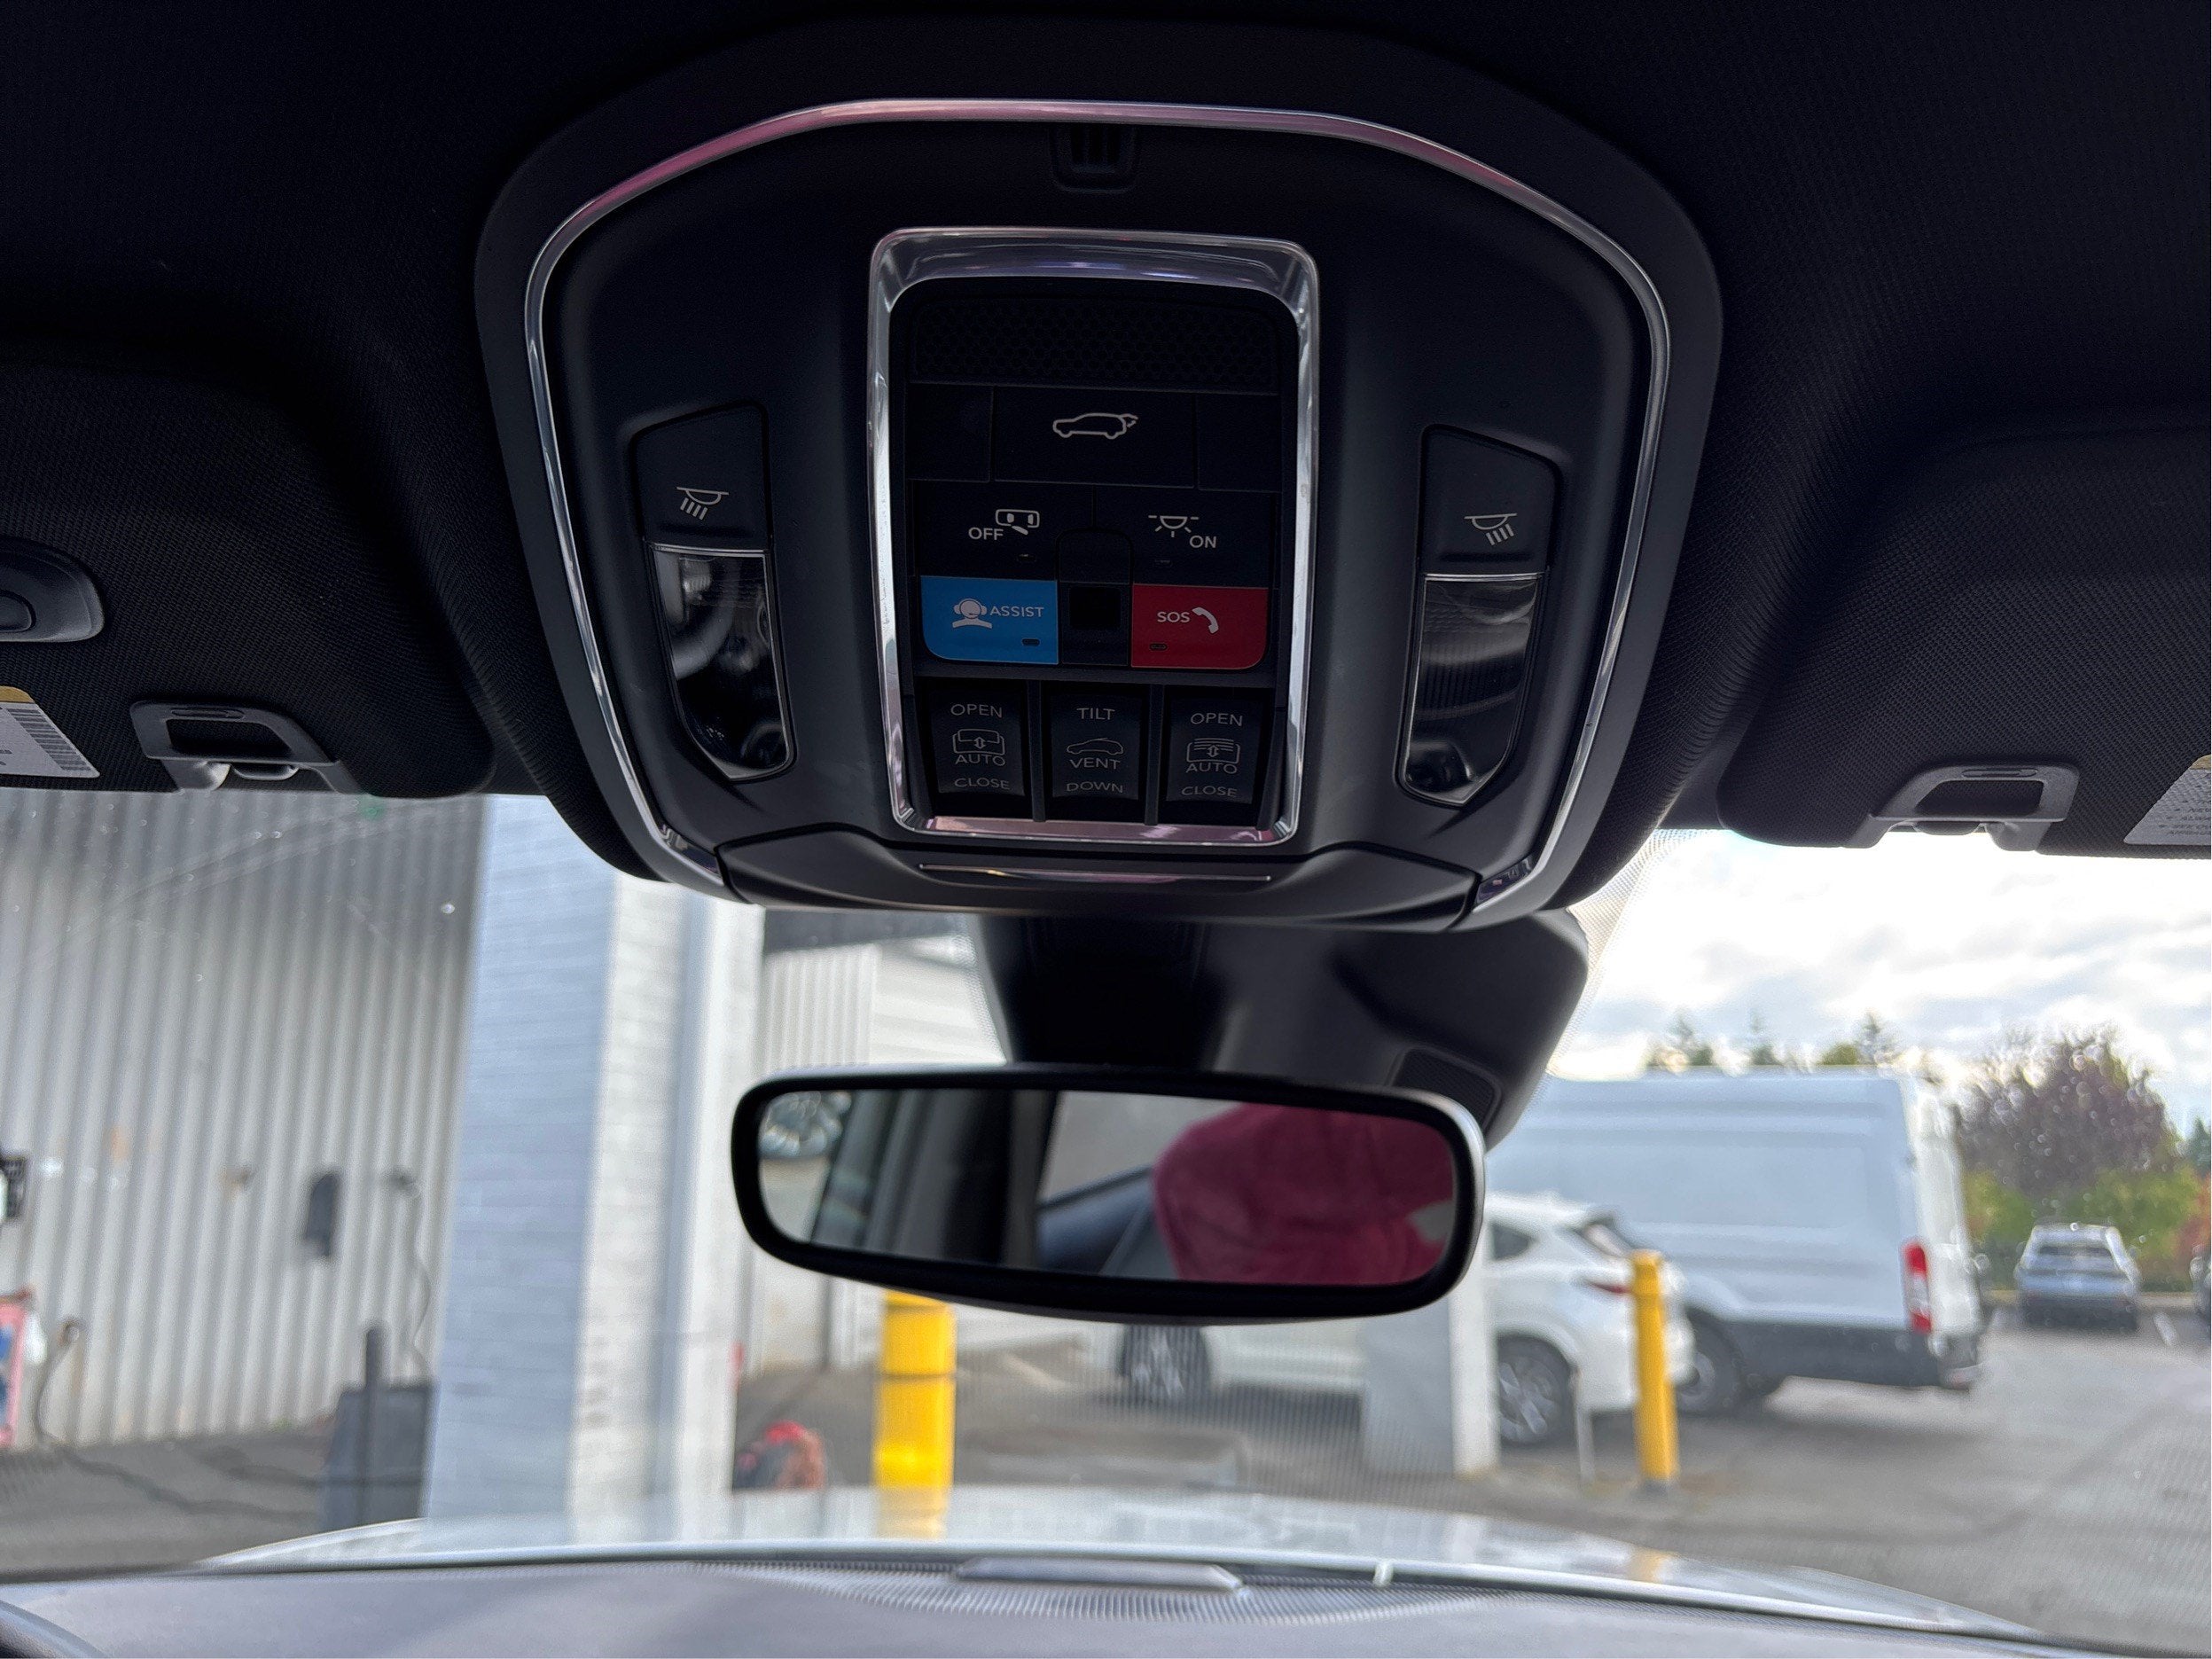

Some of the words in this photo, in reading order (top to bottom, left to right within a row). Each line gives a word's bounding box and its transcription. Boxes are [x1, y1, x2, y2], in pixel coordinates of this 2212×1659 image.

[967, 527, 1004, 541] OFF
[1189, 535, 1217, 549] ON
[989, 606, 1044, 618] ASSIST
[1156, 611, 1191, 623] SOS
[950, 703, 1003, 718] OPEN
[1076, 707, 1115, 721] TILT
[1190, 712, 1243, 727] OPEN
[954, 754, 1006, 767] AUTO
[1070, 756, 1121, 770] VENT
[1185, 762, 1239, 775] AUTO
[953, 777, 1010, 791] CLOSE
[1066, 781, 1123, 794] DOWN
[1181, 785, 1238, 798] CLOSE
